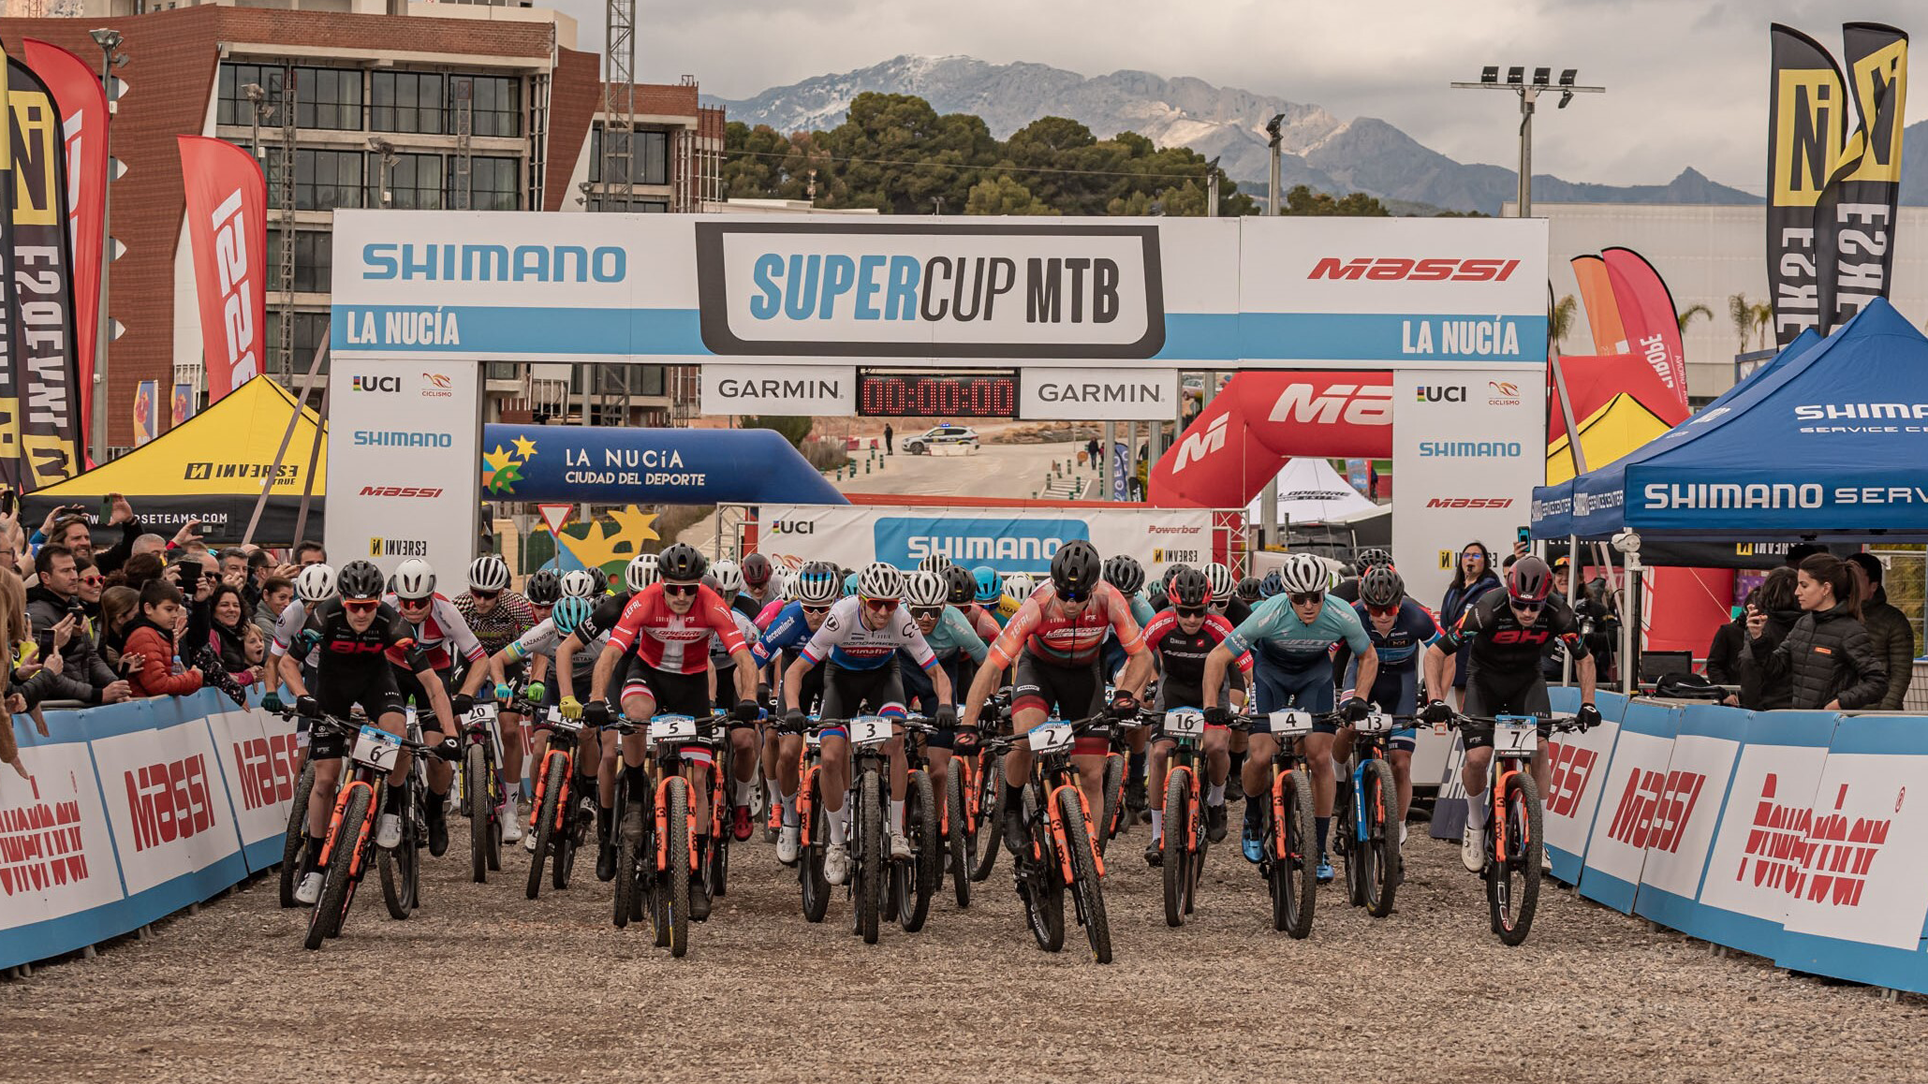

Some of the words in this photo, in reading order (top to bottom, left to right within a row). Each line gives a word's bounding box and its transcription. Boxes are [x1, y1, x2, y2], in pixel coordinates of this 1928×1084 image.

[362, 243, 627, 283] SHIMANO
[750, 253, 1016, 322] SUPERCUP
[1026, 258, 1120, 323] MTB
[347, 311, 377, 344] LA
[385, 306, 460, 345] NUCÍA
[1403, 320, 1433, 354] LA
[1443, 314, 1519, 355] NUCÍA
[362, 376, 400, 392] UCI
[863, 378, 1013, 415] 00:00:00
[1426, 386, 1466, 402] UCI
[354, 431, 452, 447] SHIMANO
[1419, 442, 1521, 457] SHIMANO
[565, 449, 591, 467] LA
[565, 471, 615, 485] CIUDAD
[618, 472, 642, 486] DEL
[645, 473, 706, 487] DEPORTE
[1645, 484, 1823, 509] SHIMANO
[780, 521, 814, 535] UCI
[1148, 525, 1201, 534] Powerbar
[908, 536, 1063, 560] SHIMANO
[469, 706, 486, 720] 20
[1285, 713, 1297, 727] 4
[668, 723, 679, 734] 5
[1176, 714, 1194, 730] 16
[1367, 717, 1382, 730] 13
[866, 724, 876, 738] 3
[1045, 729, 1058, 746] 2
[1510, 731, 1520, 748] 7
[370, 745, 382, 762] 6
